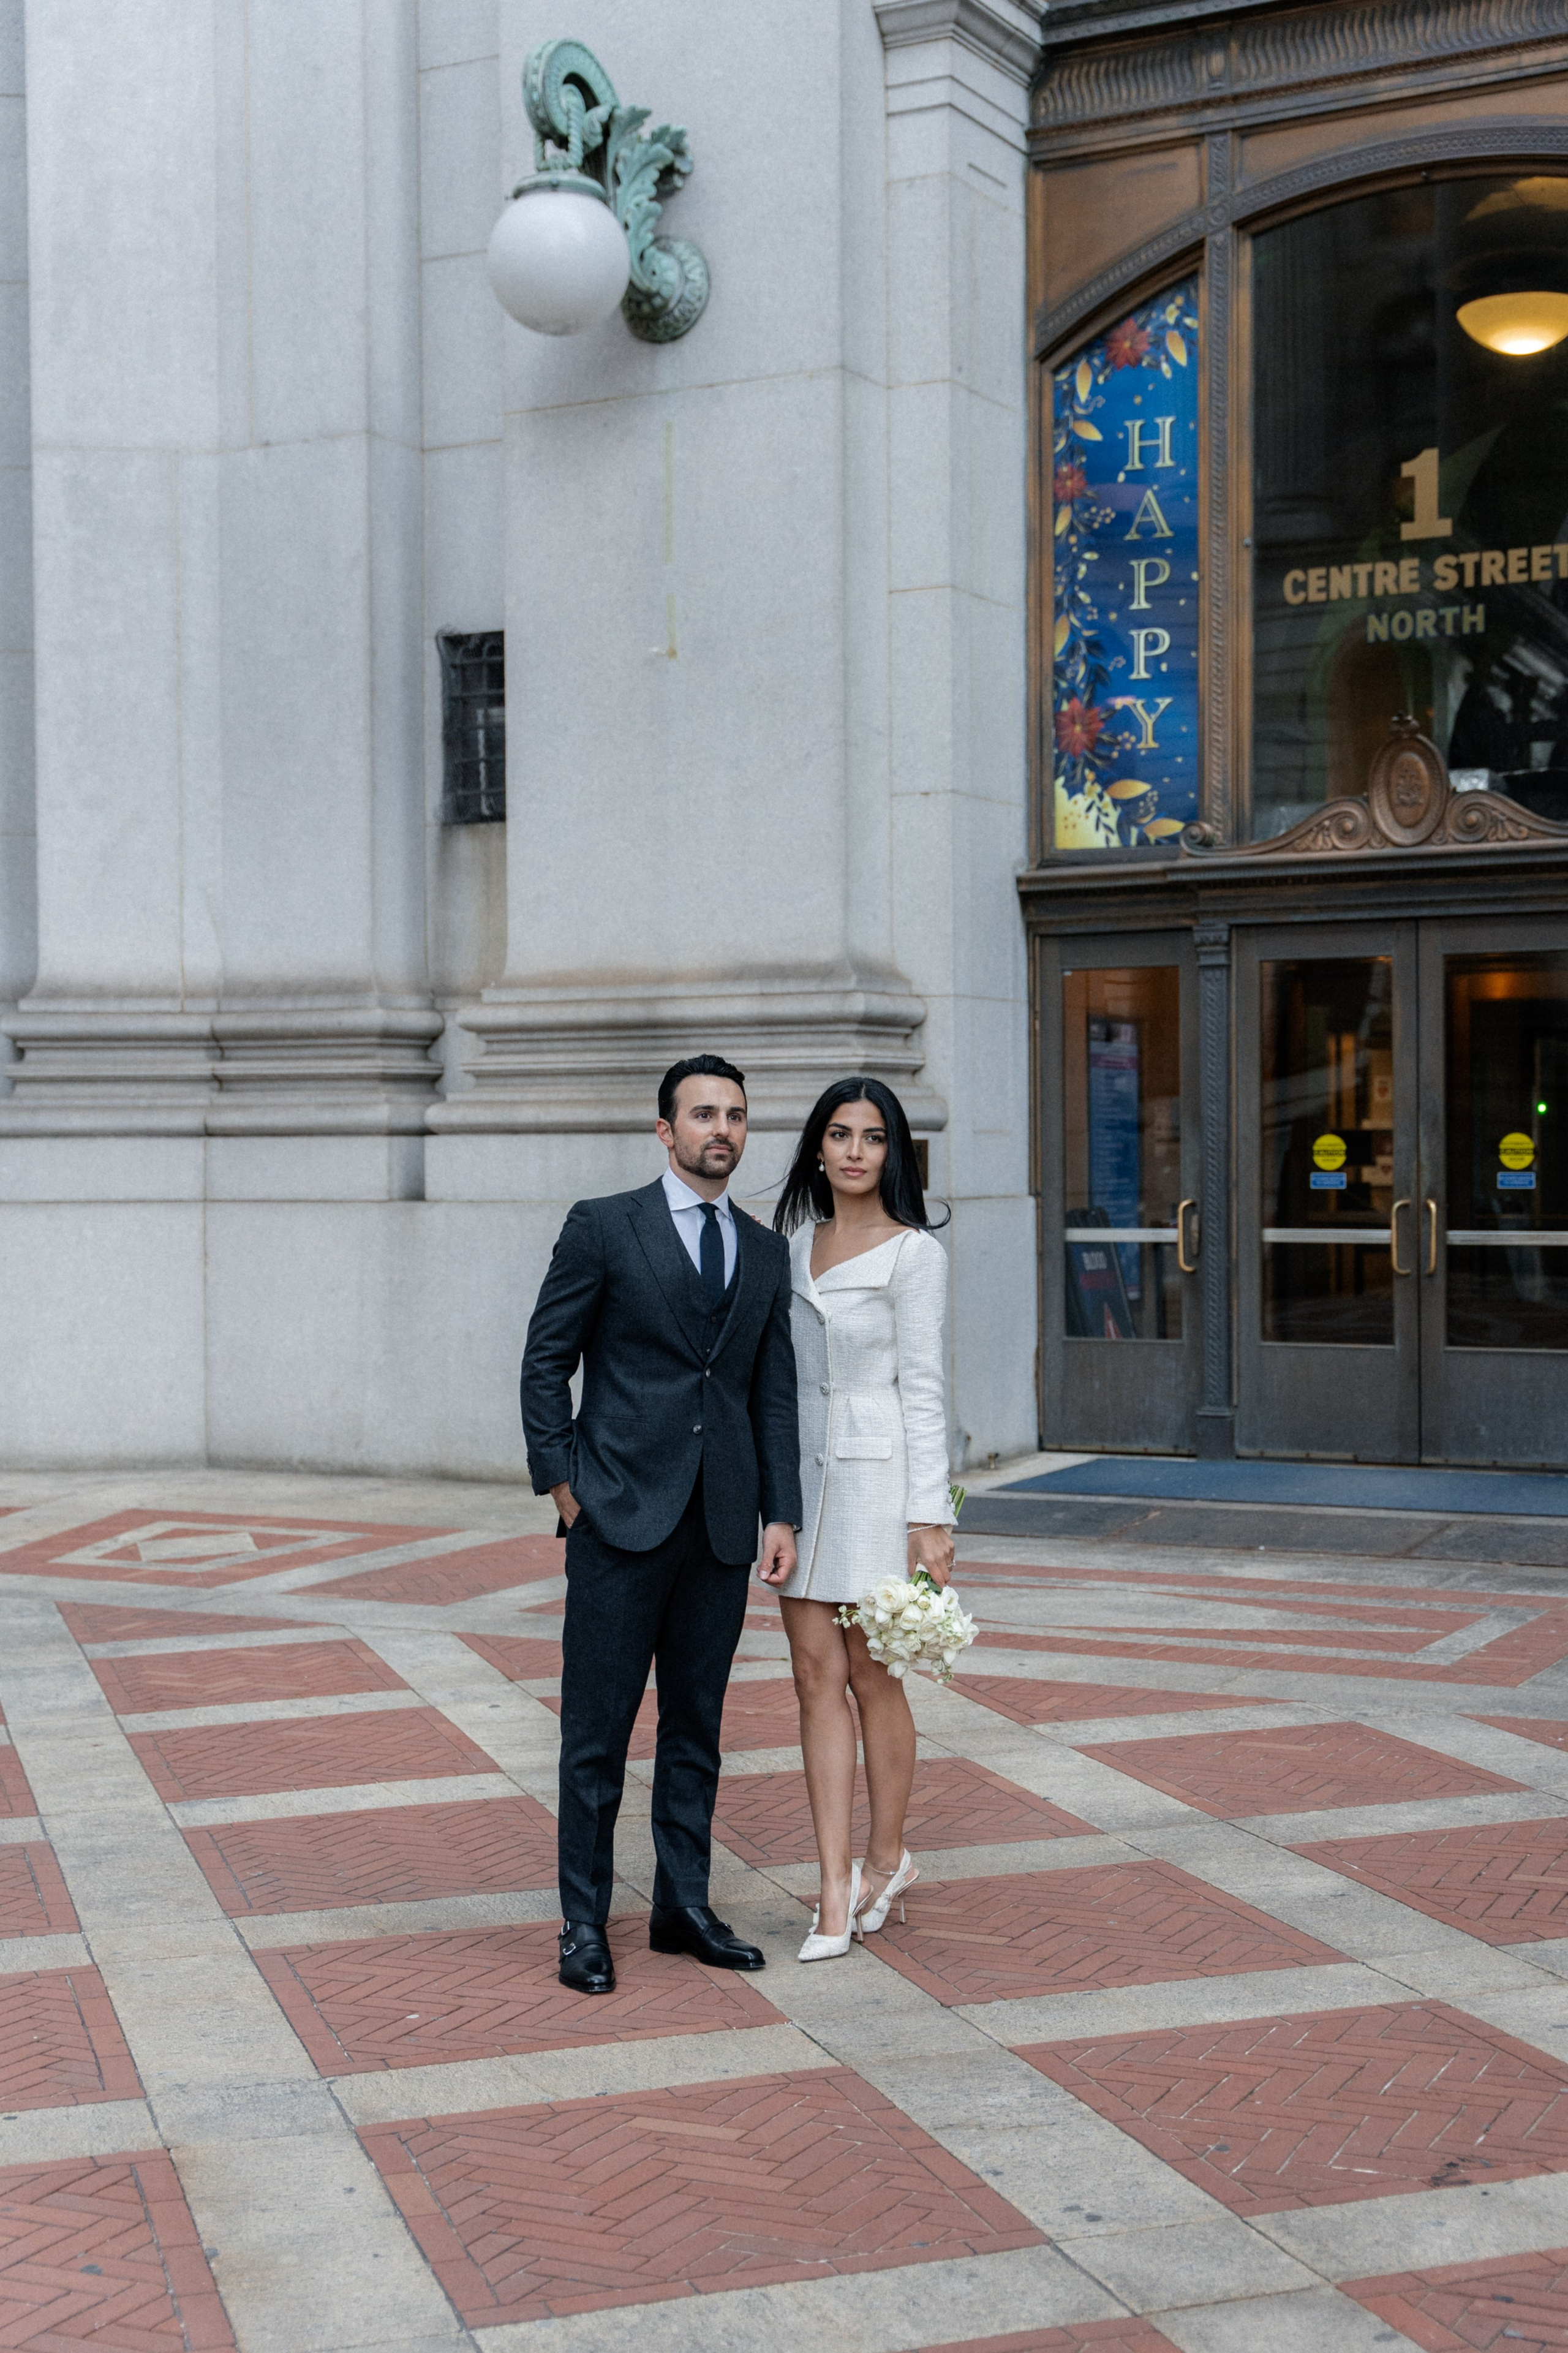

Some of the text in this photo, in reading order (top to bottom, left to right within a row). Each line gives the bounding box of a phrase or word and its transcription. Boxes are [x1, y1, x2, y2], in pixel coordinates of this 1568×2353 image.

[1400, 447, 1453, 541] 1
[1123, 415, 1177, 749] HAPPY
[1283, 543, 1568, 605] CENTRE STREET
[1366, 603, 1485, 644] NORTH
